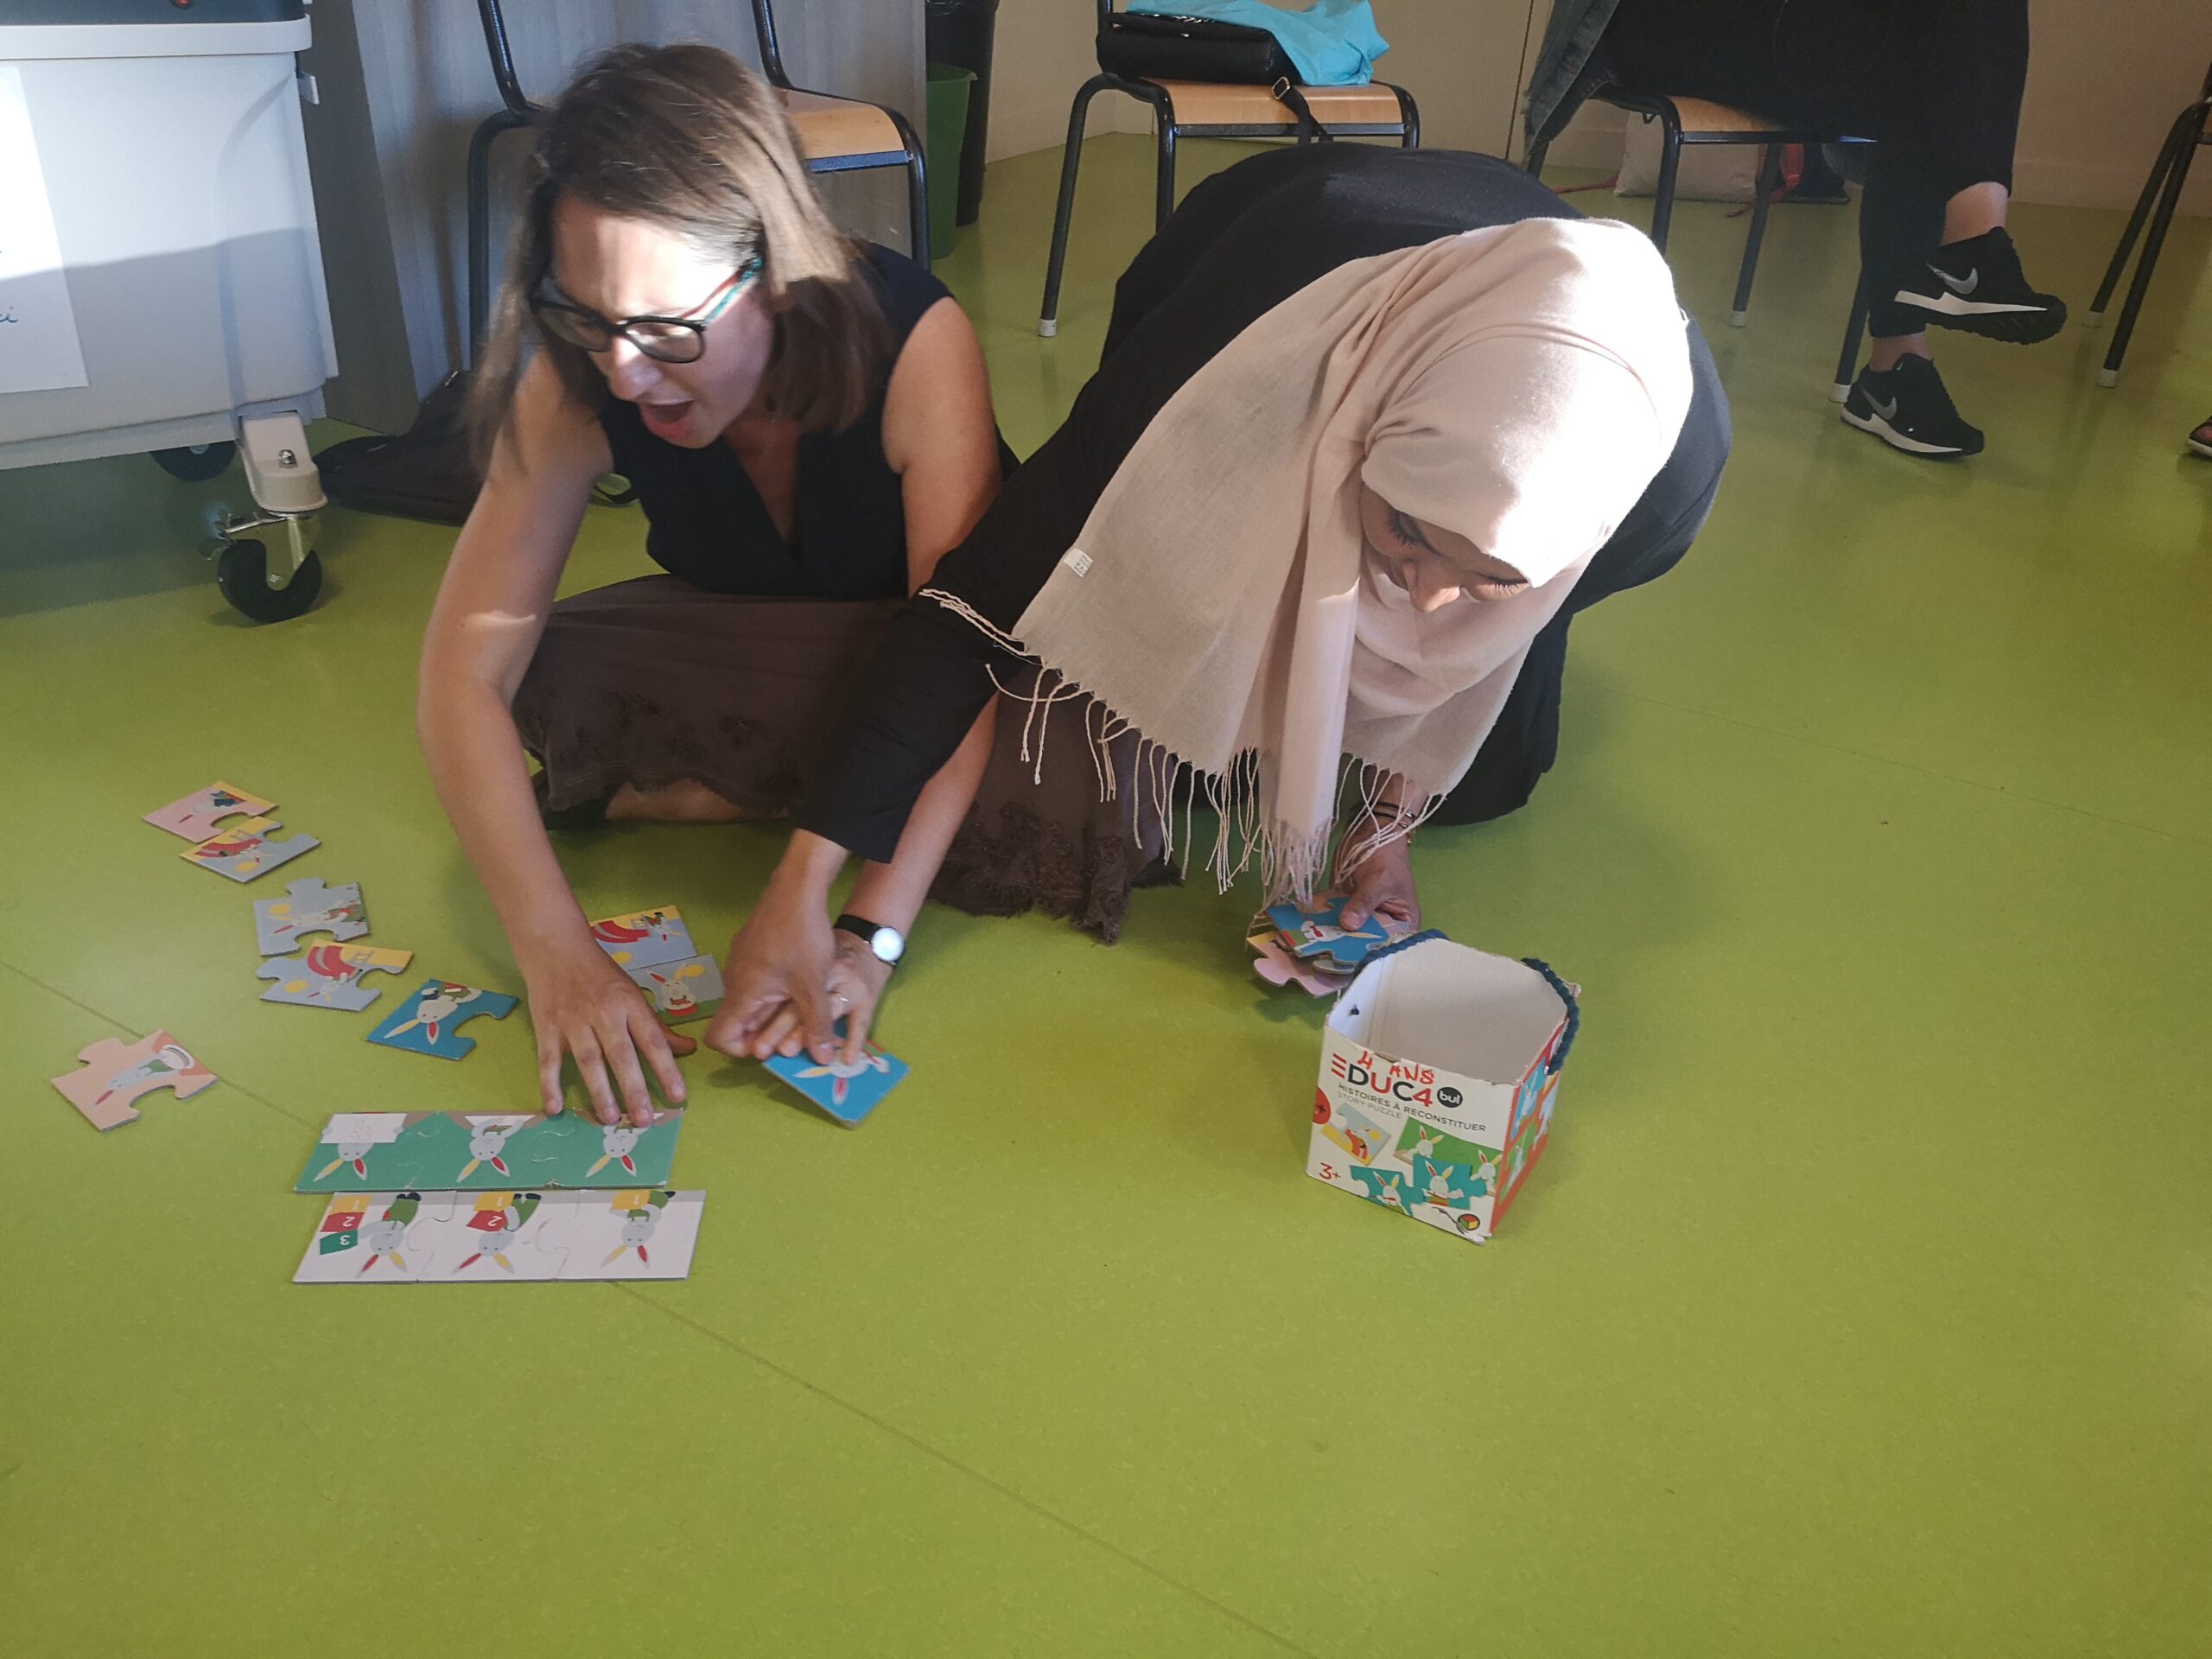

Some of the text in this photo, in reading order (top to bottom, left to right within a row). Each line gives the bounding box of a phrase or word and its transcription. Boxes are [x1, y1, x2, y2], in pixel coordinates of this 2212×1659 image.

[1389, 1064, 1435, 1084] ANS
[1338, 1091, 1402, 1120] STORY PUZZLE
[1439, 1090, 1462, 1105] bul
[1338, 1084, 1391, 1107] HISTOIRES
[1404, 1106, 1486, 1132] RECONSTITUER
[1319, 1162, 1341, 1179] 3+
